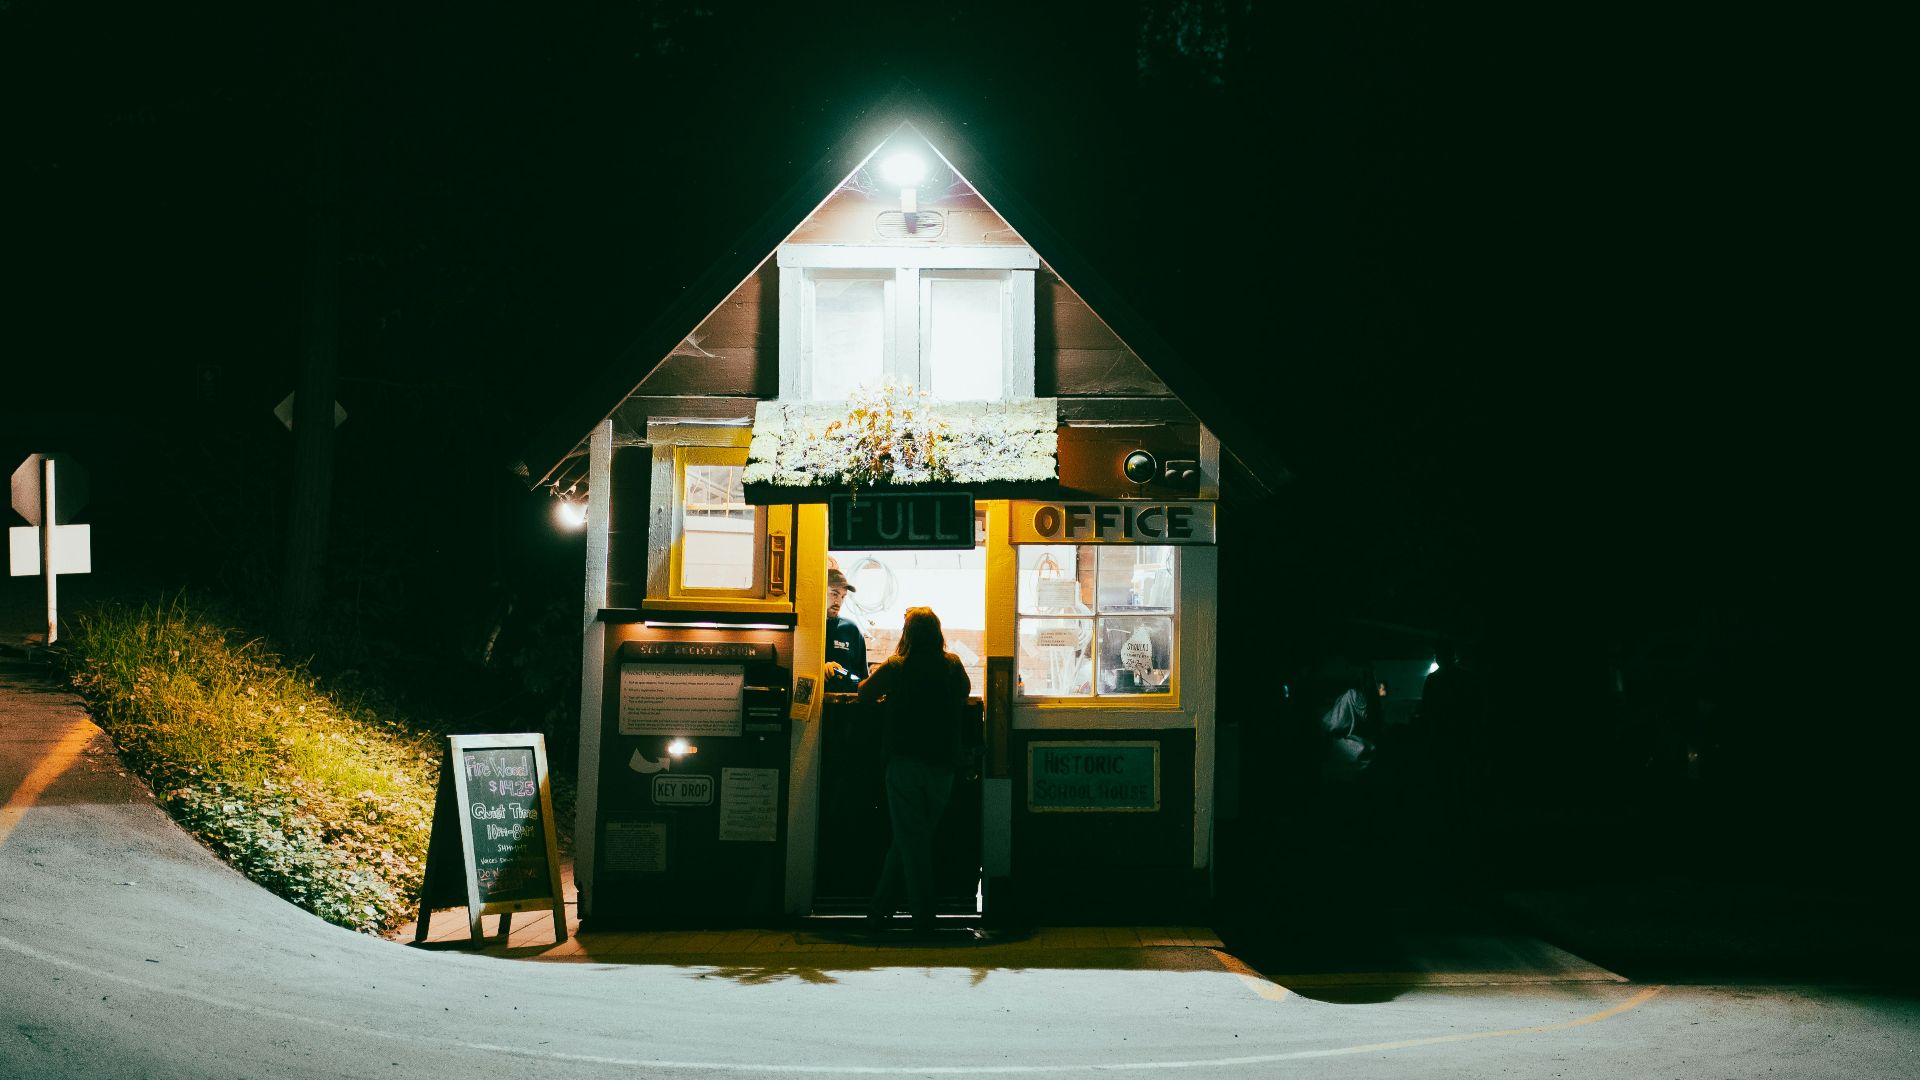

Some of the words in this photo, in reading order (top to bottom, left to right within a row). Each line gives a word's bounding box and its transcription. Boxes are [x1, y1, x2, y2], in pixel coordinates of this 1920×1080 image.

[845, 501, 960, 541] FULL
[1033, 505, 1194, 538] OFFICE
[464, 755, 491, 781] Fire
[489, 755, 529, 777] Wood
[1043, 751, 1125, 775] HISTORIC
[657, 783, 676, 797] KEY
[681, 783, 708, 797] DROP
[471, 802, 506, 820] Quiet
[509, 802, 538, 819] Time
